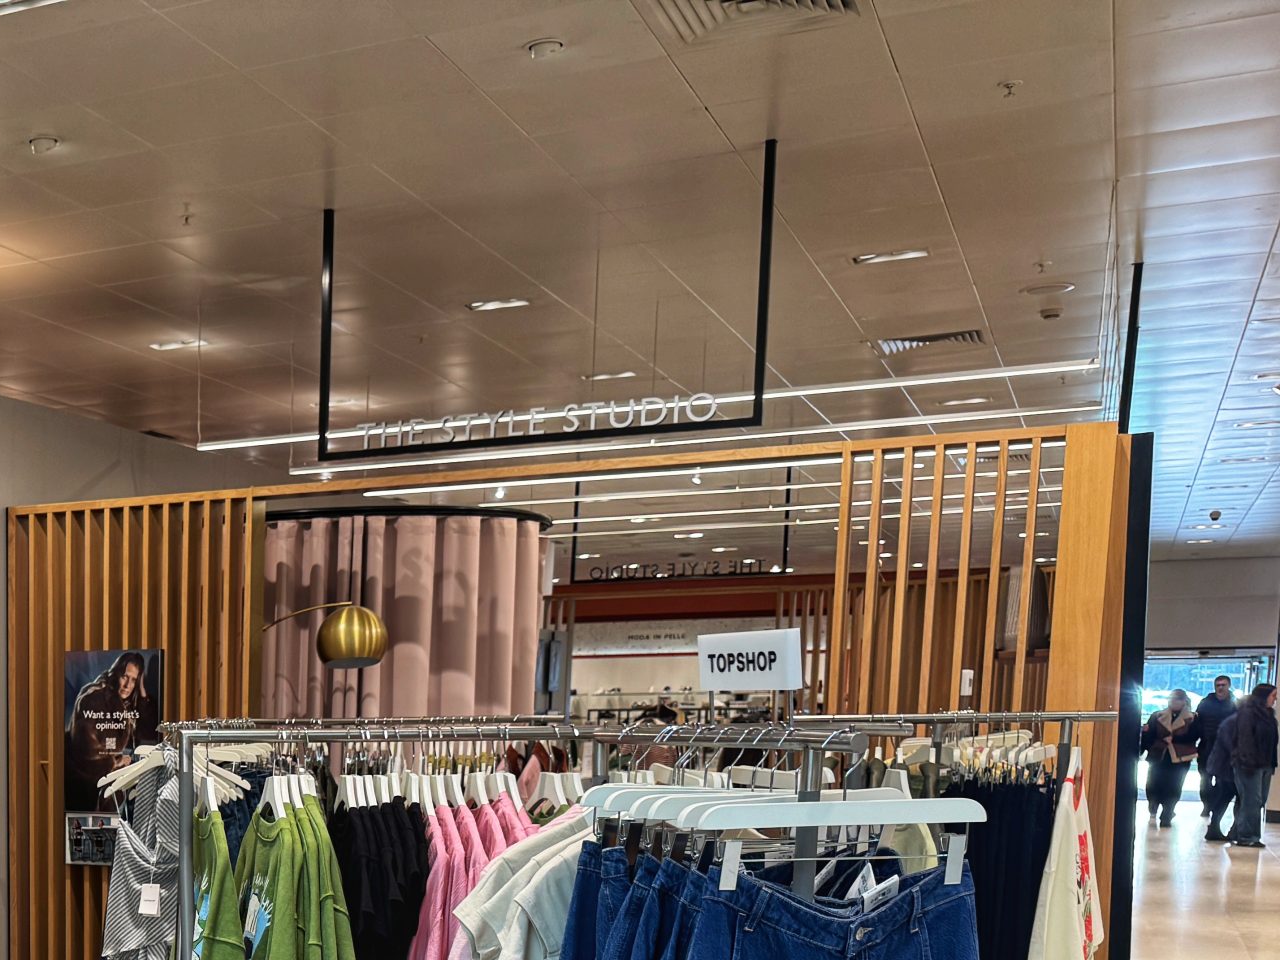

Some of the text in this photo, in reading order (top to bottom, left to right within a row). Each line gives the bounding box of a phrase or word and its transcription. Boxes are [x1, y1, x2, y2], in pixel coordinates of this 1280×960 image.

[356, 392, 718, 449] THE STYLE STUDIO
[707, 650, 777, 673] TOPSHOP
[83, 710, 104, 719] Want
[112, 710, 140, 721] stylist's
[95, 721, 126, 731] opinion?
